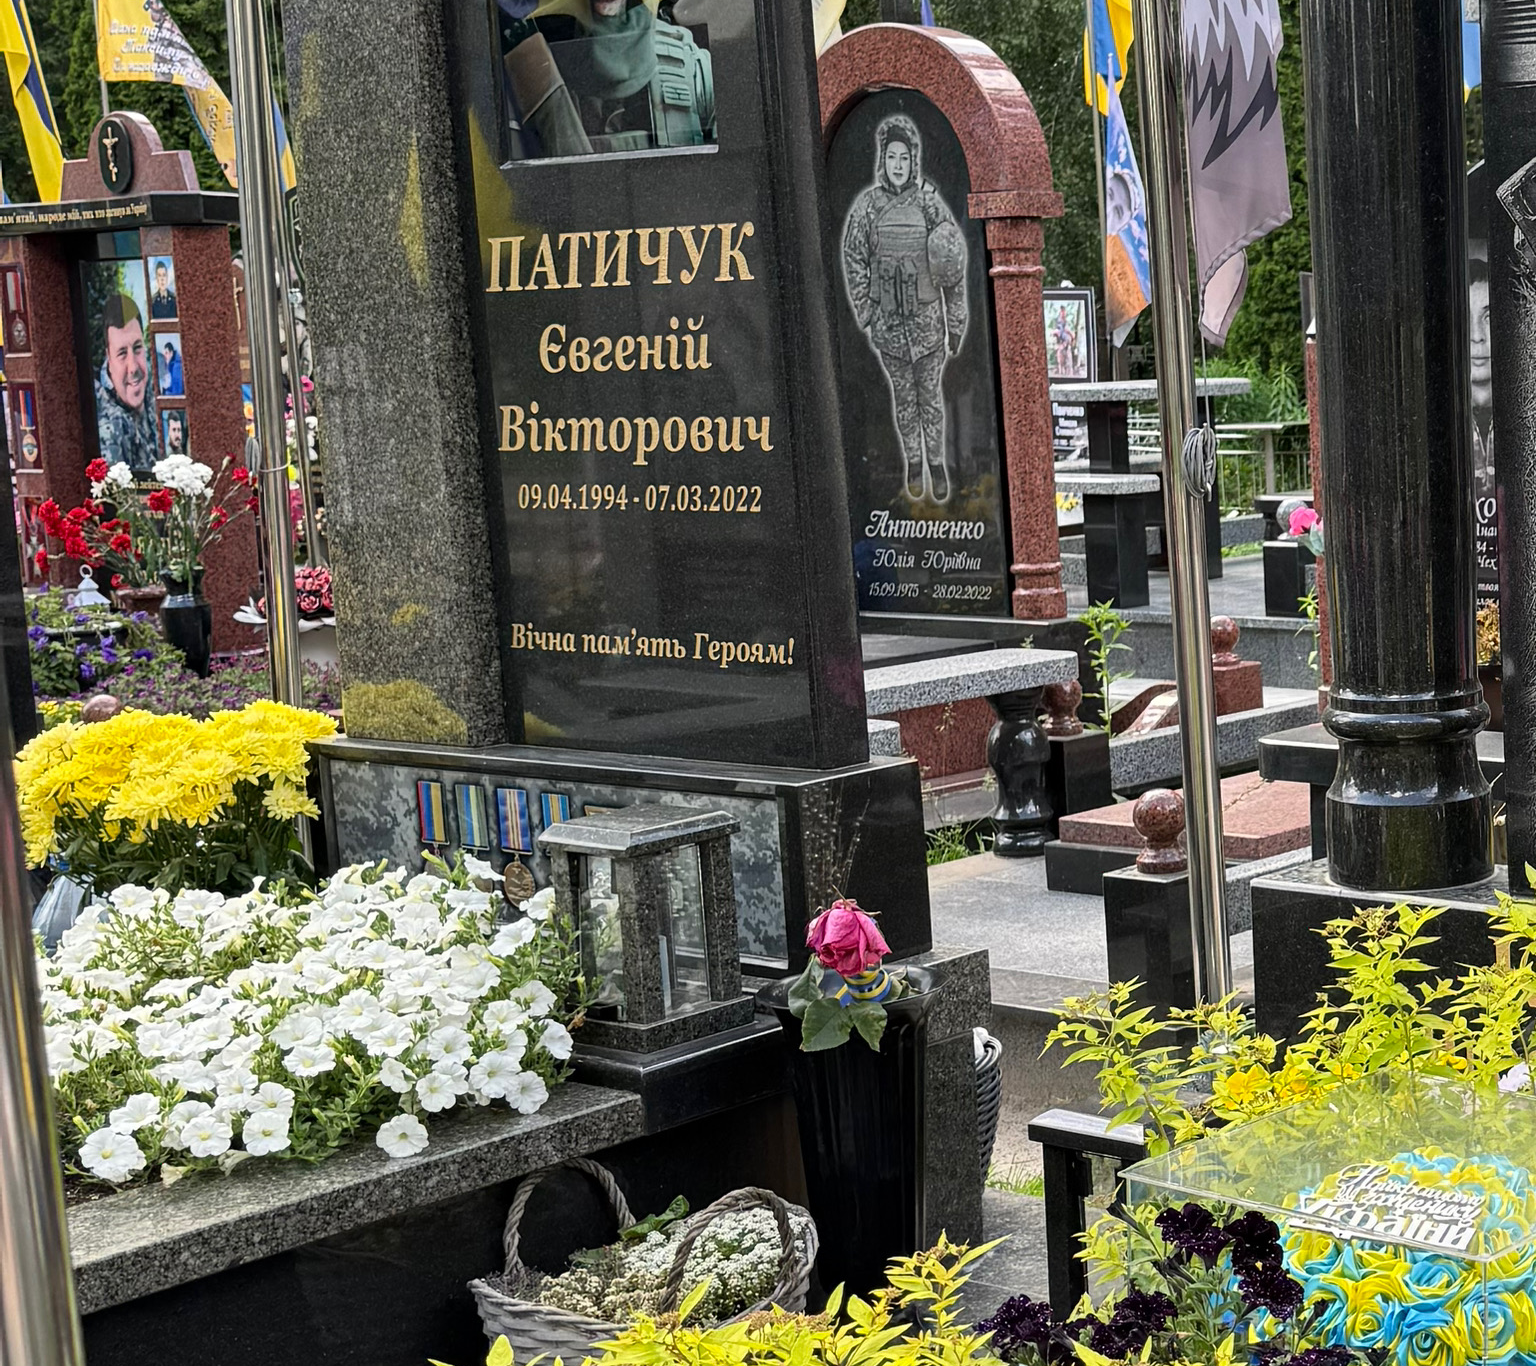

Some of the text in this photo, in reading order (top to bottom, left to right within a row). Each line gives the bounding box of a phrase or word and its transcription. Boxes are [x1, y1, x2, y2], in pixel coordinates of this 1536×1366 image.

[485, 222, 755, 293] ПАТИЧУК
[539, 316, 712, 374] Євгеній
[499, 400, 774, 466] Вікторович
[518, 484, 628, 511] 09.04.1994
[645, 485, 762, 514] 07.03.2022
[865, 509, 985, 540] Антоненко
[873, 548, 982, 573] Юлія Юріївна
[932, 584, 993, 600] 28.02.2022
[511, 623, 577, 653] Вічна
[693, 631, 796, 669] Героям!
